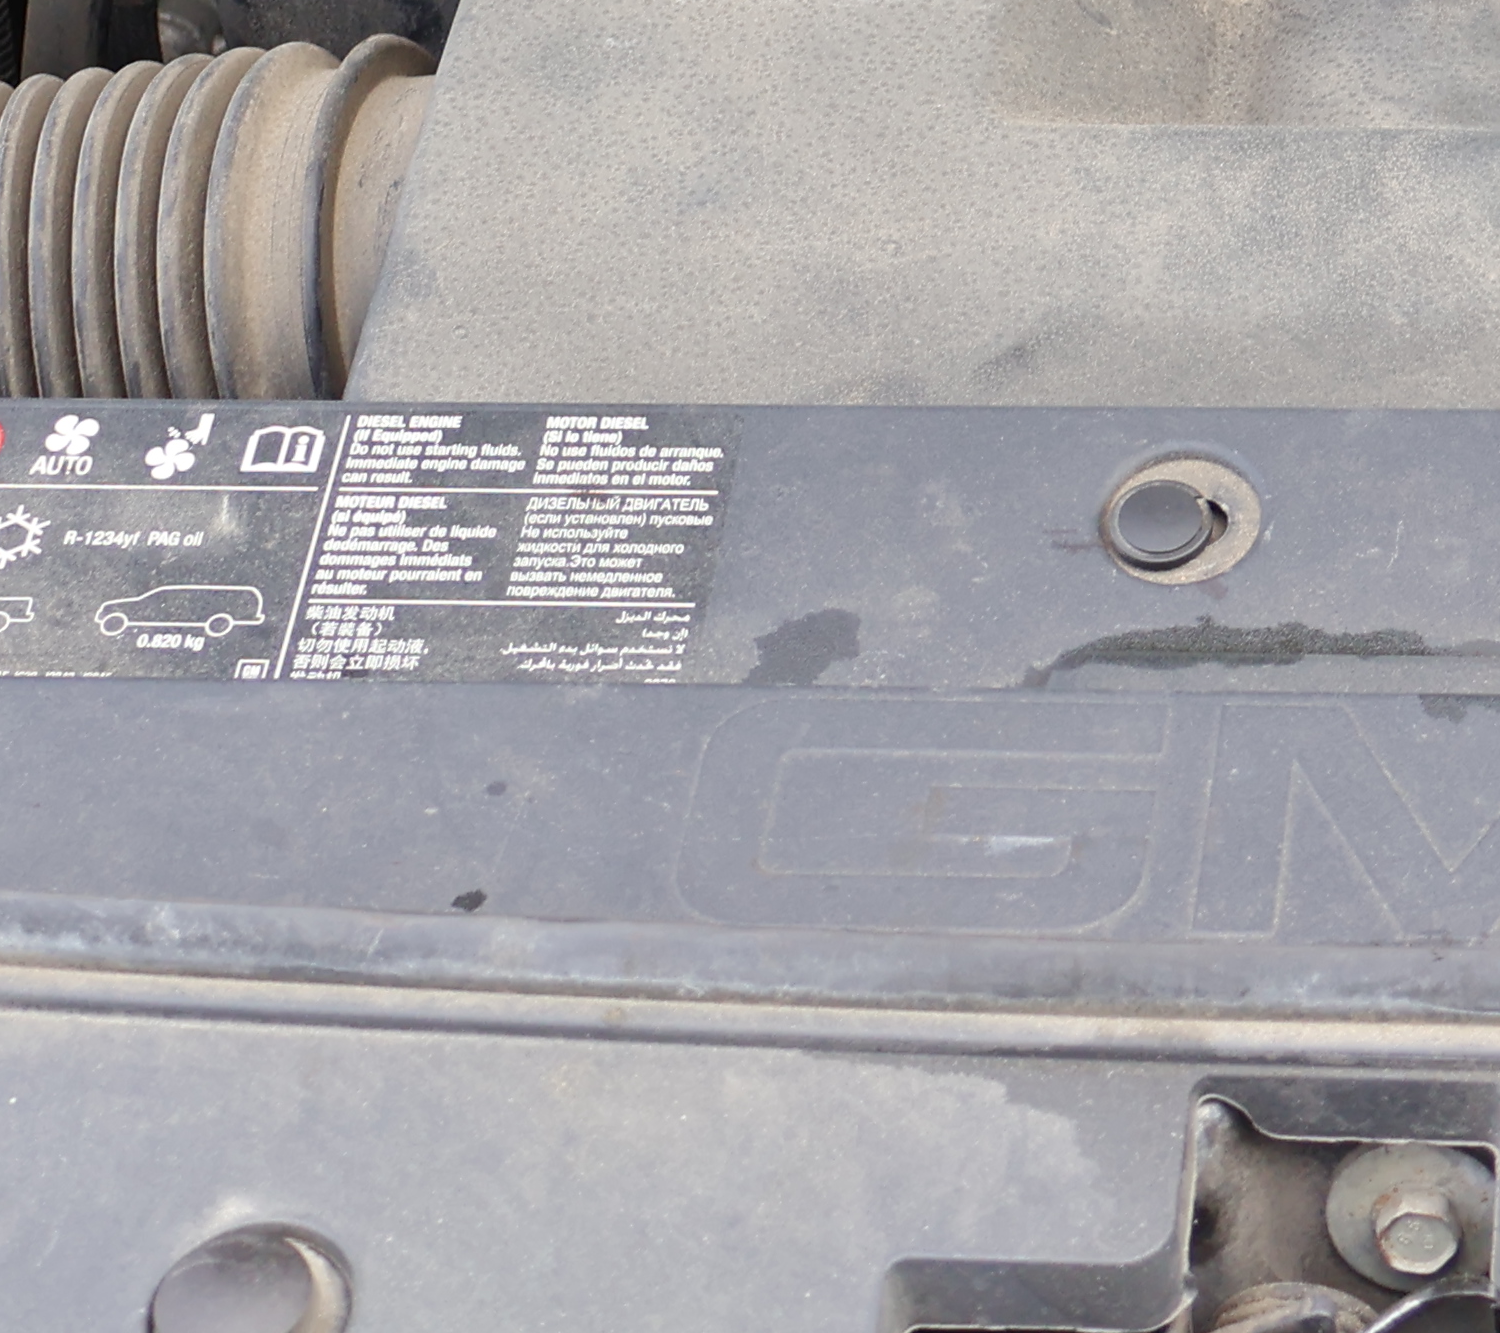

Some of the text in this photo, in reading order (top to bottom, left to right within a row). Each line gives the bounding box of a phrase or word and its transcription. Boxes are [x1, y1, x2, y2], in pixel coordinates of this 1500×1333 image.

[356, 415, 463, 429] DIESEL ENGINE
[546, 416, 650, 430] MOTOR DIESEL
[372, 429, 443, 444] Equipped)
[542, 430, 623, 445] (Si lo tiene)
[350, 443, 522, 458] Do not use starting fluids.
[539, 445, 724, 460] No use fluidos de arranque.
[29, 455, 93, 476] AUTO
[345, 457, 526, 472] Immediate engine damage
[535, 459, 714, 473] Se pueden producir daños
[341, 471, 413, 484] can result.
[611, 475, 630, 485] en
[631, 473, 647, 485] el
[648, 474, 691, 486] motor.
[334, 495, 448, 509] MOTEUR DIESEL
[526, 496, 710, 512] ДИЗЕЛЬНЫЙ ДВИГАТЕЛЬ
[331, 510, 406, 525] (si équipé)
[524, 513, 714, 528] (если установлен) пусковые
[63, 530, 204, 548] R-1234yf PAG oil
[327, 525, 497, 541] Ne pas utiliser de liquide
[520, 526, 629, 541] Не используйте
[323, 539, 449, 554] dedémarrage. Des
[516, 542, 685, 555] жидкости для холодного
[319, 554, 473, 568] dommages immédiats
[598, 558, 643, 568] может
[315, 568, 483, 583] au moteur pourraient en
[510, 571, 663, 584] вызвать немедленное
[310, 581, 368, 595] résulter.
[506, 586, 676, 599] повреждение двигателя.
[305, 605, 395, 621] 柴油发动机
[136, 633, 205, 651] 0.820 kg
[293, 653, 421, 671] 否则会立即损坏
